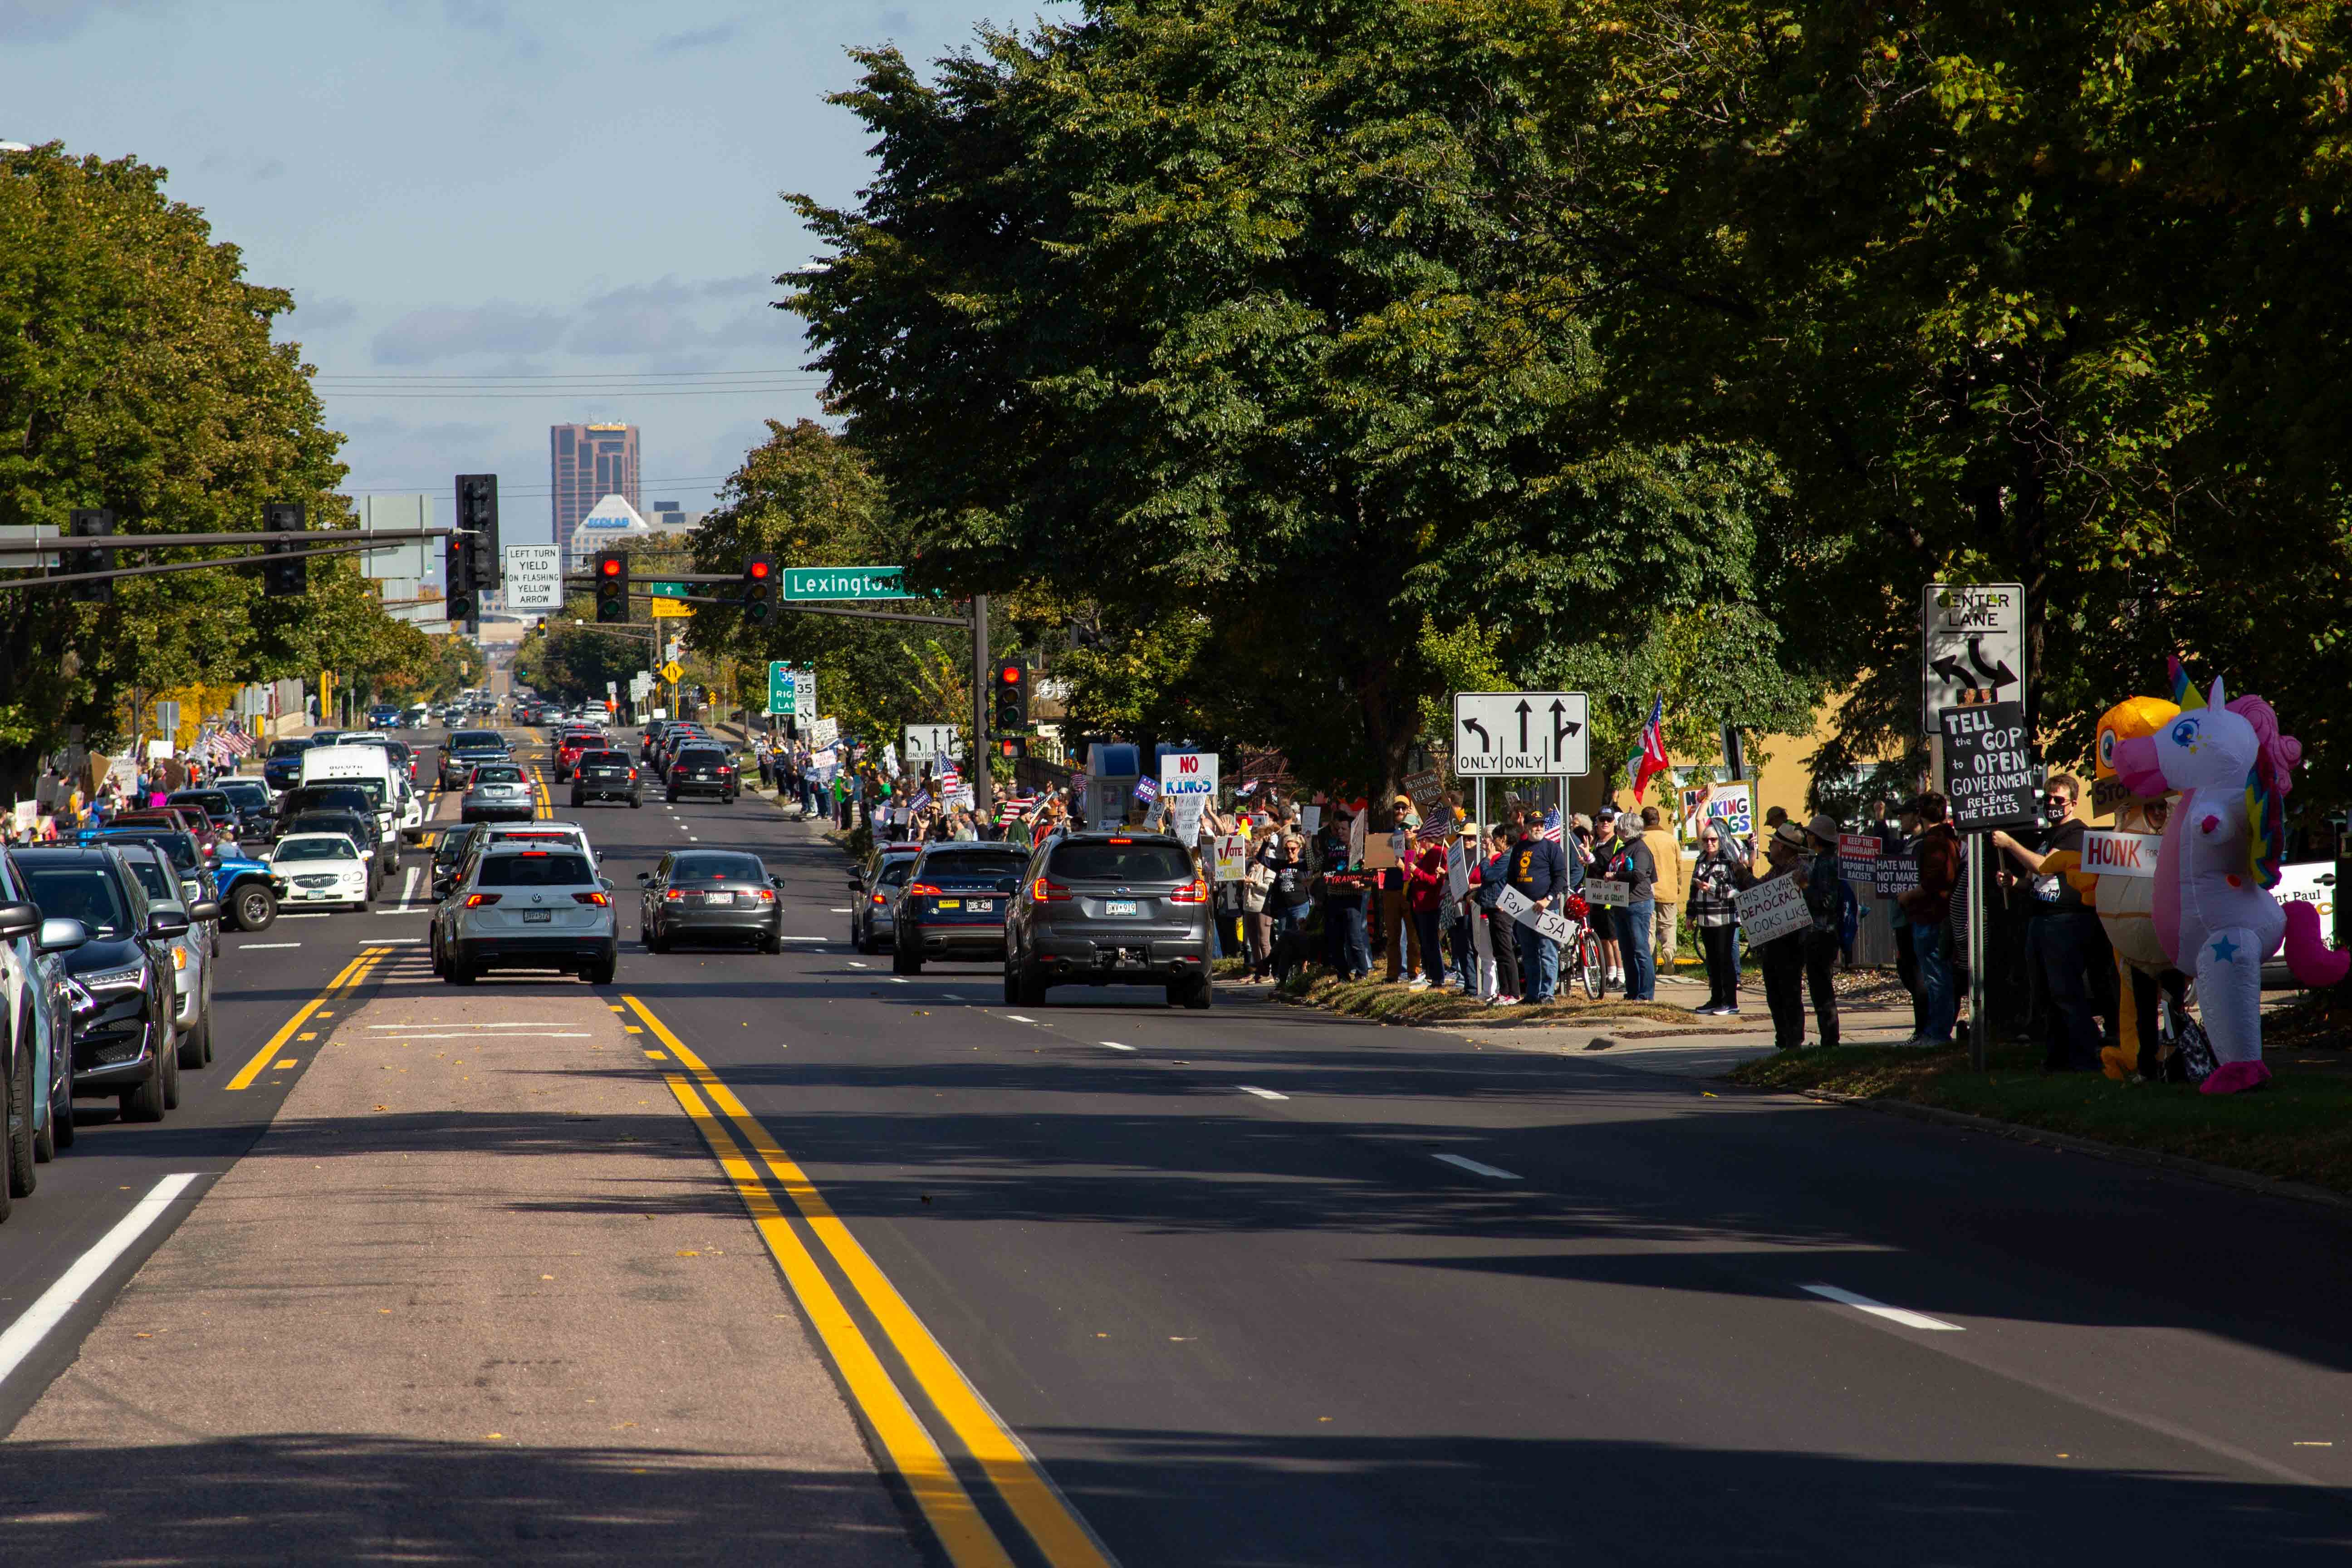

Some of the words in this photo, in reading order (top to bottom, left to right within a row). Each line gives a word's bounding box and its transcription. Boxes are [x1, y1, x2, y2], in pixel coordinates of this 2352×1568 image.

[588, 517, 629, 528] ECOLAB
[519, 561, 548, 570] YIELD
[794, 575, 894, 597] Lexingto
[1949, 613, 1998, 626] LANE
[781, 672, 794, 682] 35
[797, 684, 812, 694] 35
[1945, 710, 1994, 735] TELL
[1955, 738, 1971, 747] the
[1982, 727, 2022, 750] GOP
[1180, 756, 1199, 773] NO
[1460, 756, 1499, 769] ONLY
[1505, 756, 1543, 768] ONLY
[1953, 760, 1964, 769] to
[1975, 750, 2026, 774] OPEN
[1166, 775, 1212, 794] KINGS
[1406, 774, 1438, 789] REJECTING
[1952, 770, 2032, 796] GOVERNMENT
[1412, 785, 1441, 802] KINGS
[911, 795, 928, 810] RESIST!
[1152, 802, 1161, 811] NO
[1186, 795, 1205, 807] KINGS
[1968, 794, 2015, 808] RELEASE
[1958, 808, 1978, 820] THE
[1982, 802, 2019, 817] FILES
[2048, 809, 2064, 818] ICE
[1847, 837, 1862, 846] KEEP
[1863, 838, 1873, 847] THE
[1842, 845, 1879, 855] IMMIGRANTS
[2087, 838, 2142, 868] HONK
[2145, 849, 2159, 858] FOR
[1843, 862, 1864, 871] DEPORT
[1877, 860, 1897, 870] HATE
[1899, 860, 1918, 870] WILL
[1324, 875, 1362, 883] TYRANNY
[1847, 871, 1872, 880] RACISTS
[1877, 872, 1894, 882] NOT
[1896, 872, 1918, 882] MAKE
[1591, 880, 1602, 888] HATE
[1877, 884, 1888, 893] US
[1736, 889, 1759, 905] THIS
[1762, 885, 1772, 897] IS
[1772, 877, 1793, 892] WHAT
[2293, 889, 2321, 901] Paul
[1504, 892, 1523, 915] Pay
[1741, 887, 1802, 921] DEMOCRACY
[1535, 912, 1565, 939] T.S.A.
[1746, 913, 1782, 935] LOOKS
[1785, 904, 1808, 921] LIKE
